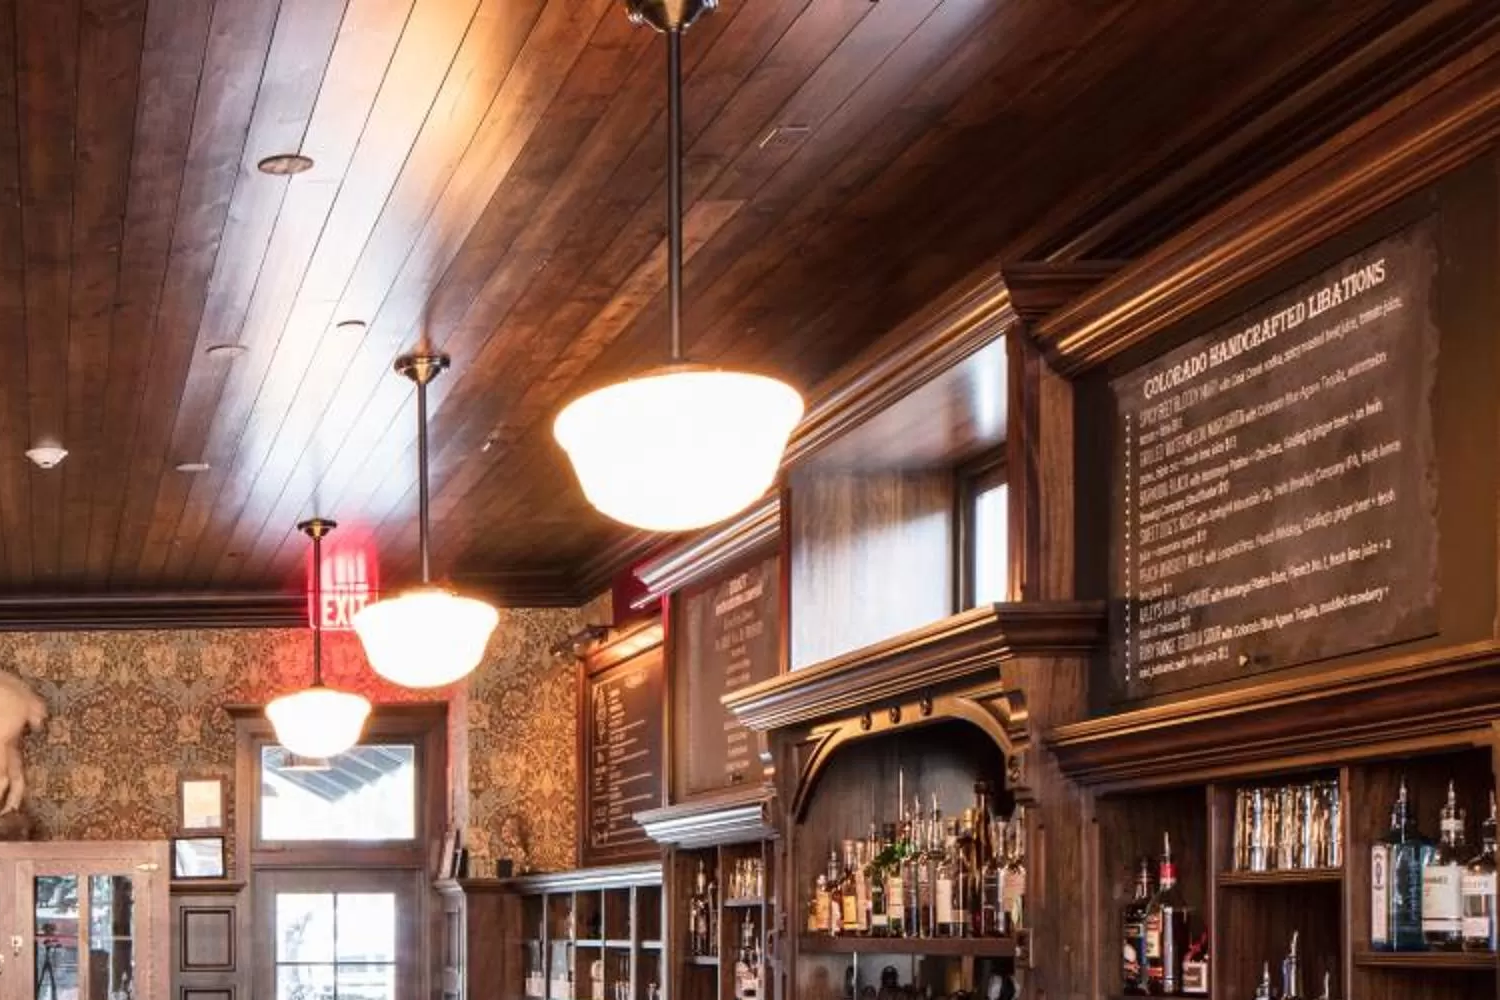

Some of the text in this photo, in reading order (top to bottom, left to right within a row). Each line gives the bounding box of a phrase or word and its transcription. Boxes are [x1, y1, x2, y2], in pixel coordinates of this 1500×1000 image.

[1143, 353, 1208, 400] COLORADO
[1210, 303, 1305, 369] HANDCRAFTED
[1309, 259, 1386, 318] LIBATIONS
